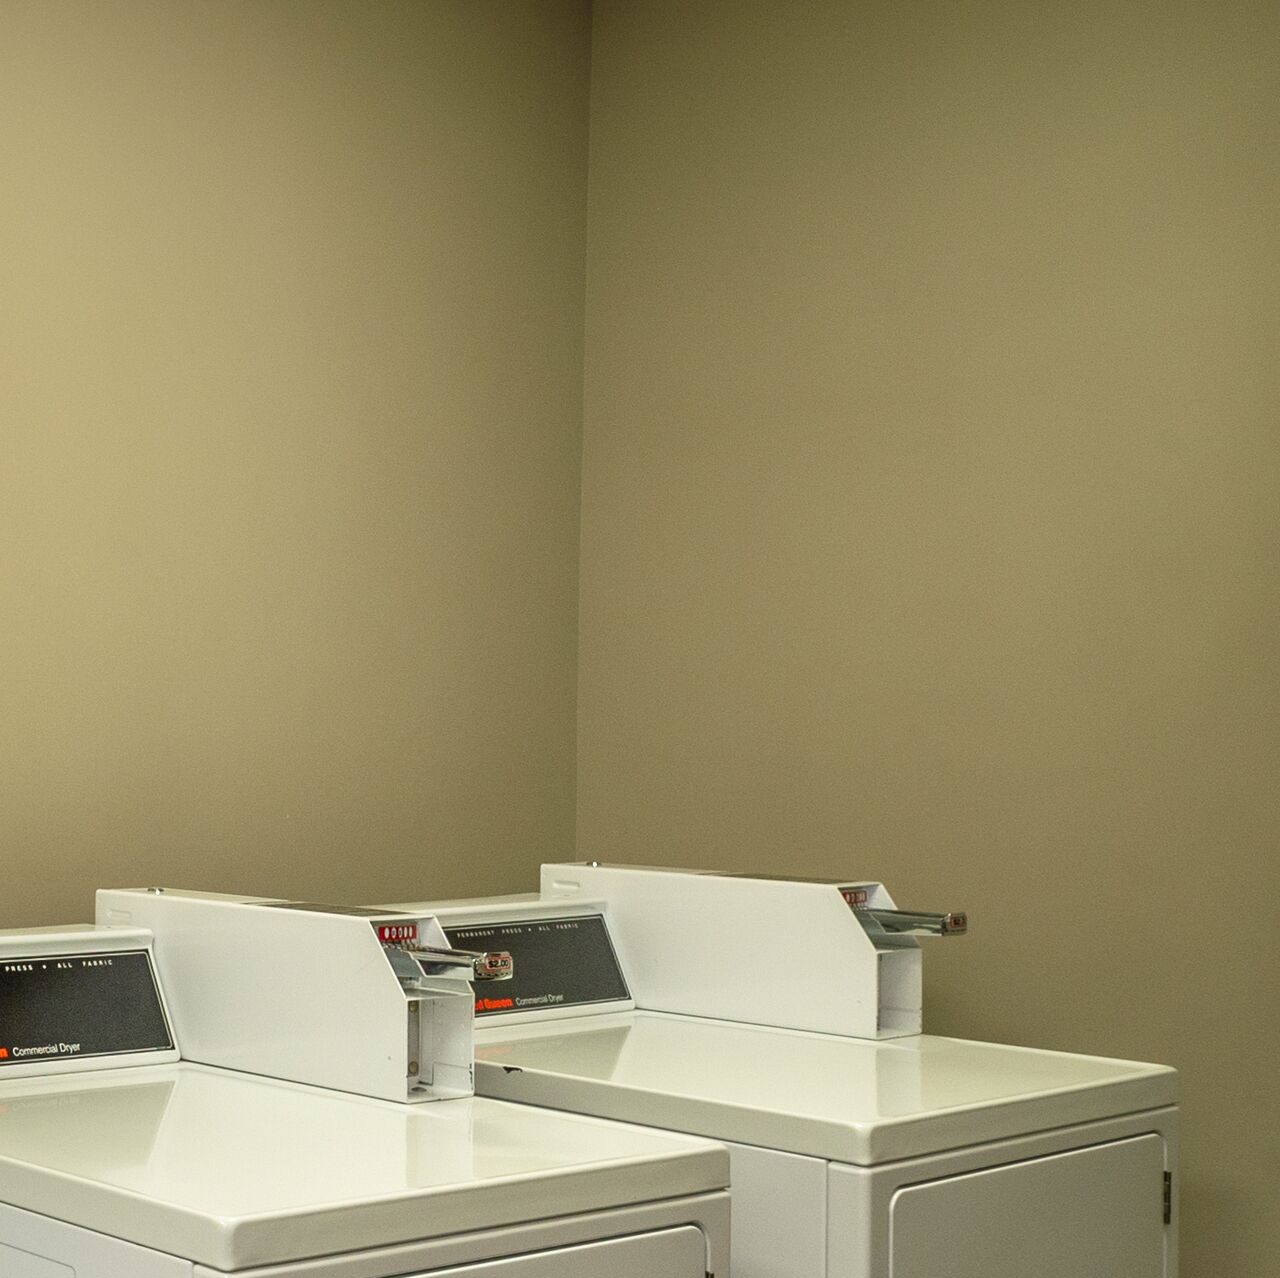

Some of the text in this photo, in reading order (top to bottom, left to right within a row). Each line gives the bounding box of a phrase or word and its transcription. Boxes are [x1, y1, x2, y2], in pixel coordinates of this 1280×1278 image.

[5, 964, 34, 972] PRESS
[82, 959, 113, 967] FABRIC
[12, 1043, 59, 1057] Commercial
[59, 1042, 81, 1054] Dryer
